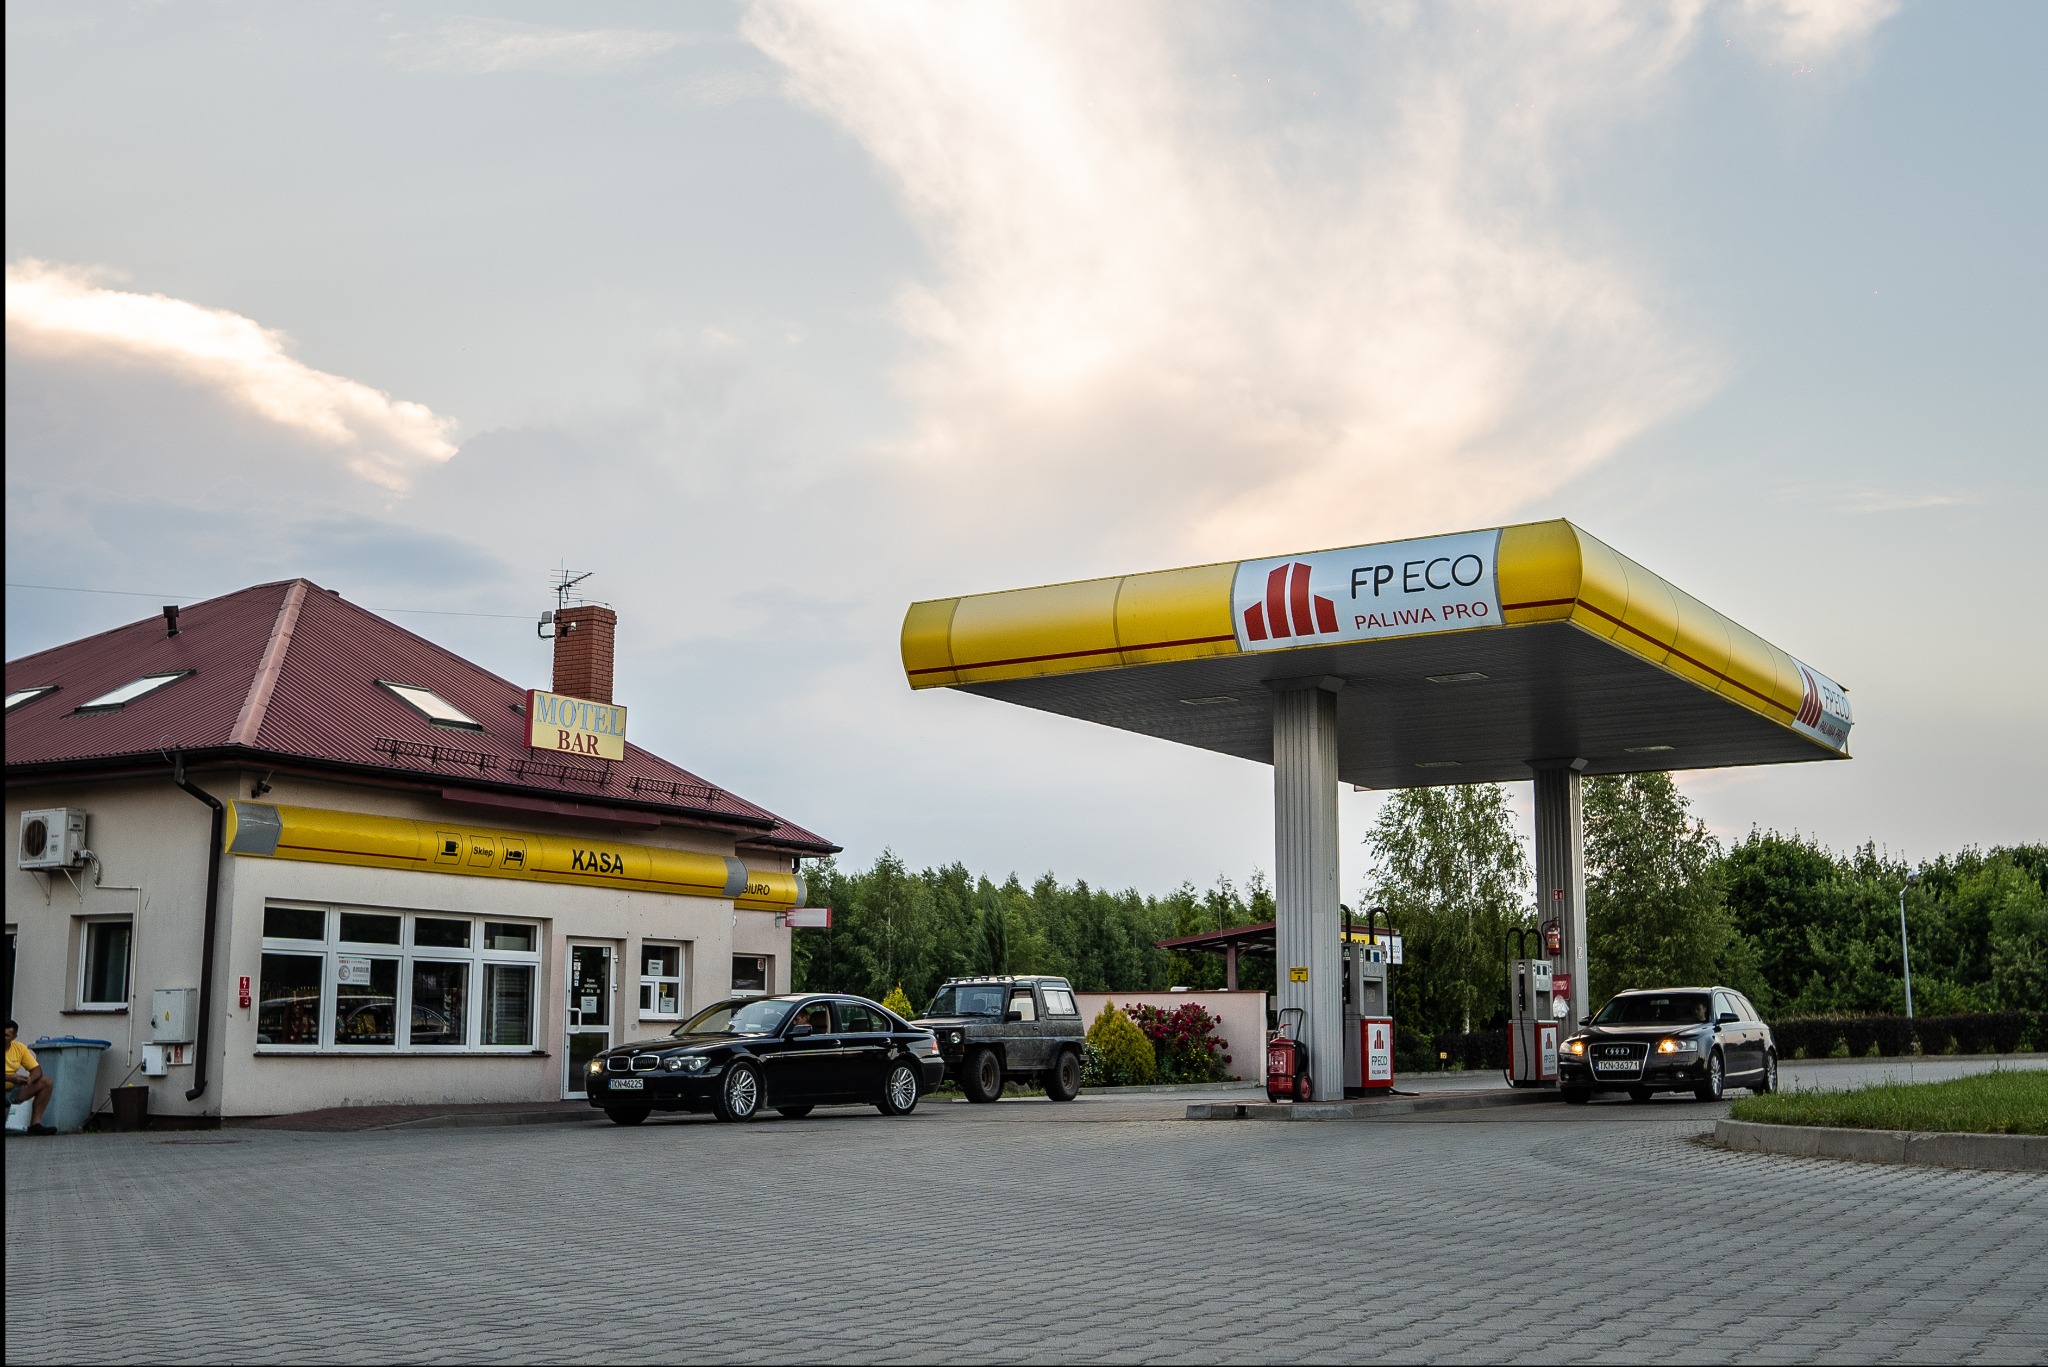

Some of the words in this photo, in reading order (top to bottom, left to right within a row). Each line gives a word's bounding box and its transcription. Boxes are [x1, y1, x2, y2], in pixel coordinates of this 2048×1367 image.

[1351, 565, 1394, 600] FP
[1403, 554, 1483, 594] ECO
[1354, 608, 1436, 631] PALIWA
[1442, 601, 1489, 621] PRO
[535, 694, 624, 737] MOTEL
[557, 729, 600, 756] BAR
[473, 845, 493, 858] Sklep
[571, 849, 625, 875] KASA
[1599, 1061, 1614, 1070] TKN
[1615, 1061, 1638, 1070] 36371
